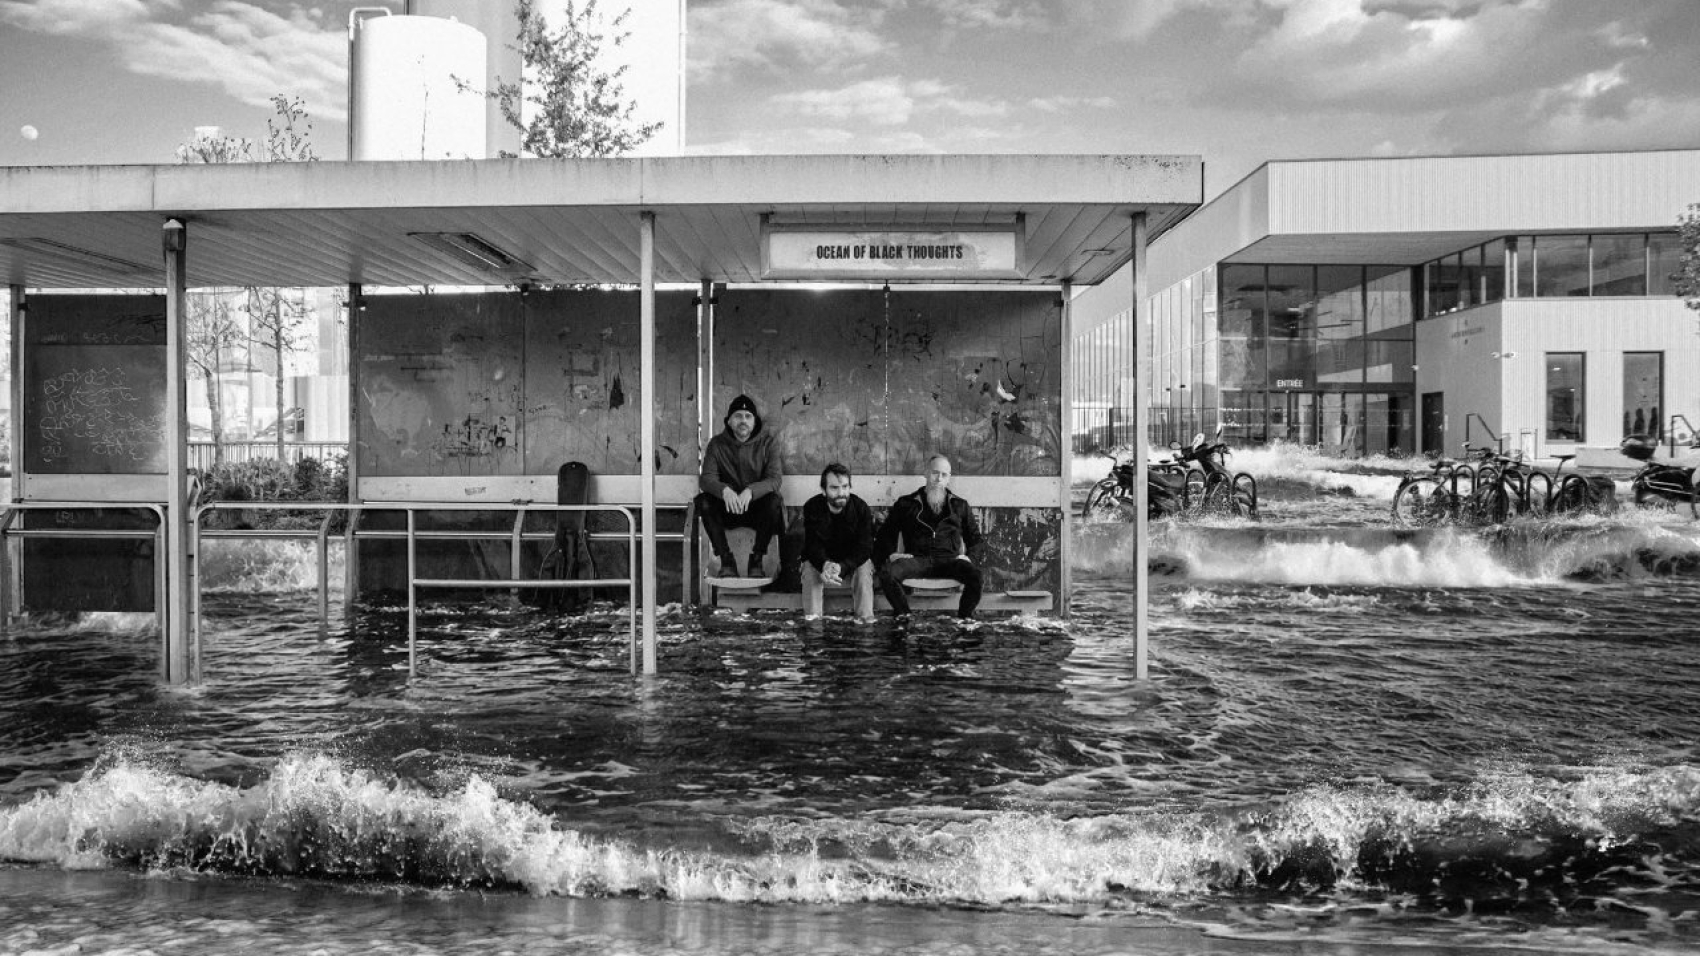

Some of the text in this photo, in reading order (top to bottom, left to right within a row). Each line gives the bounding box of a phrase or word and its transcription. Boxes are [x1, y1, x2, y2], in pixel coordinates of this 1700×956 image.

[816, 245, 963, 259] OCEAN OF BLACK THOUGHTS
[1277, 378, 1304, 388] ENTRÉE
